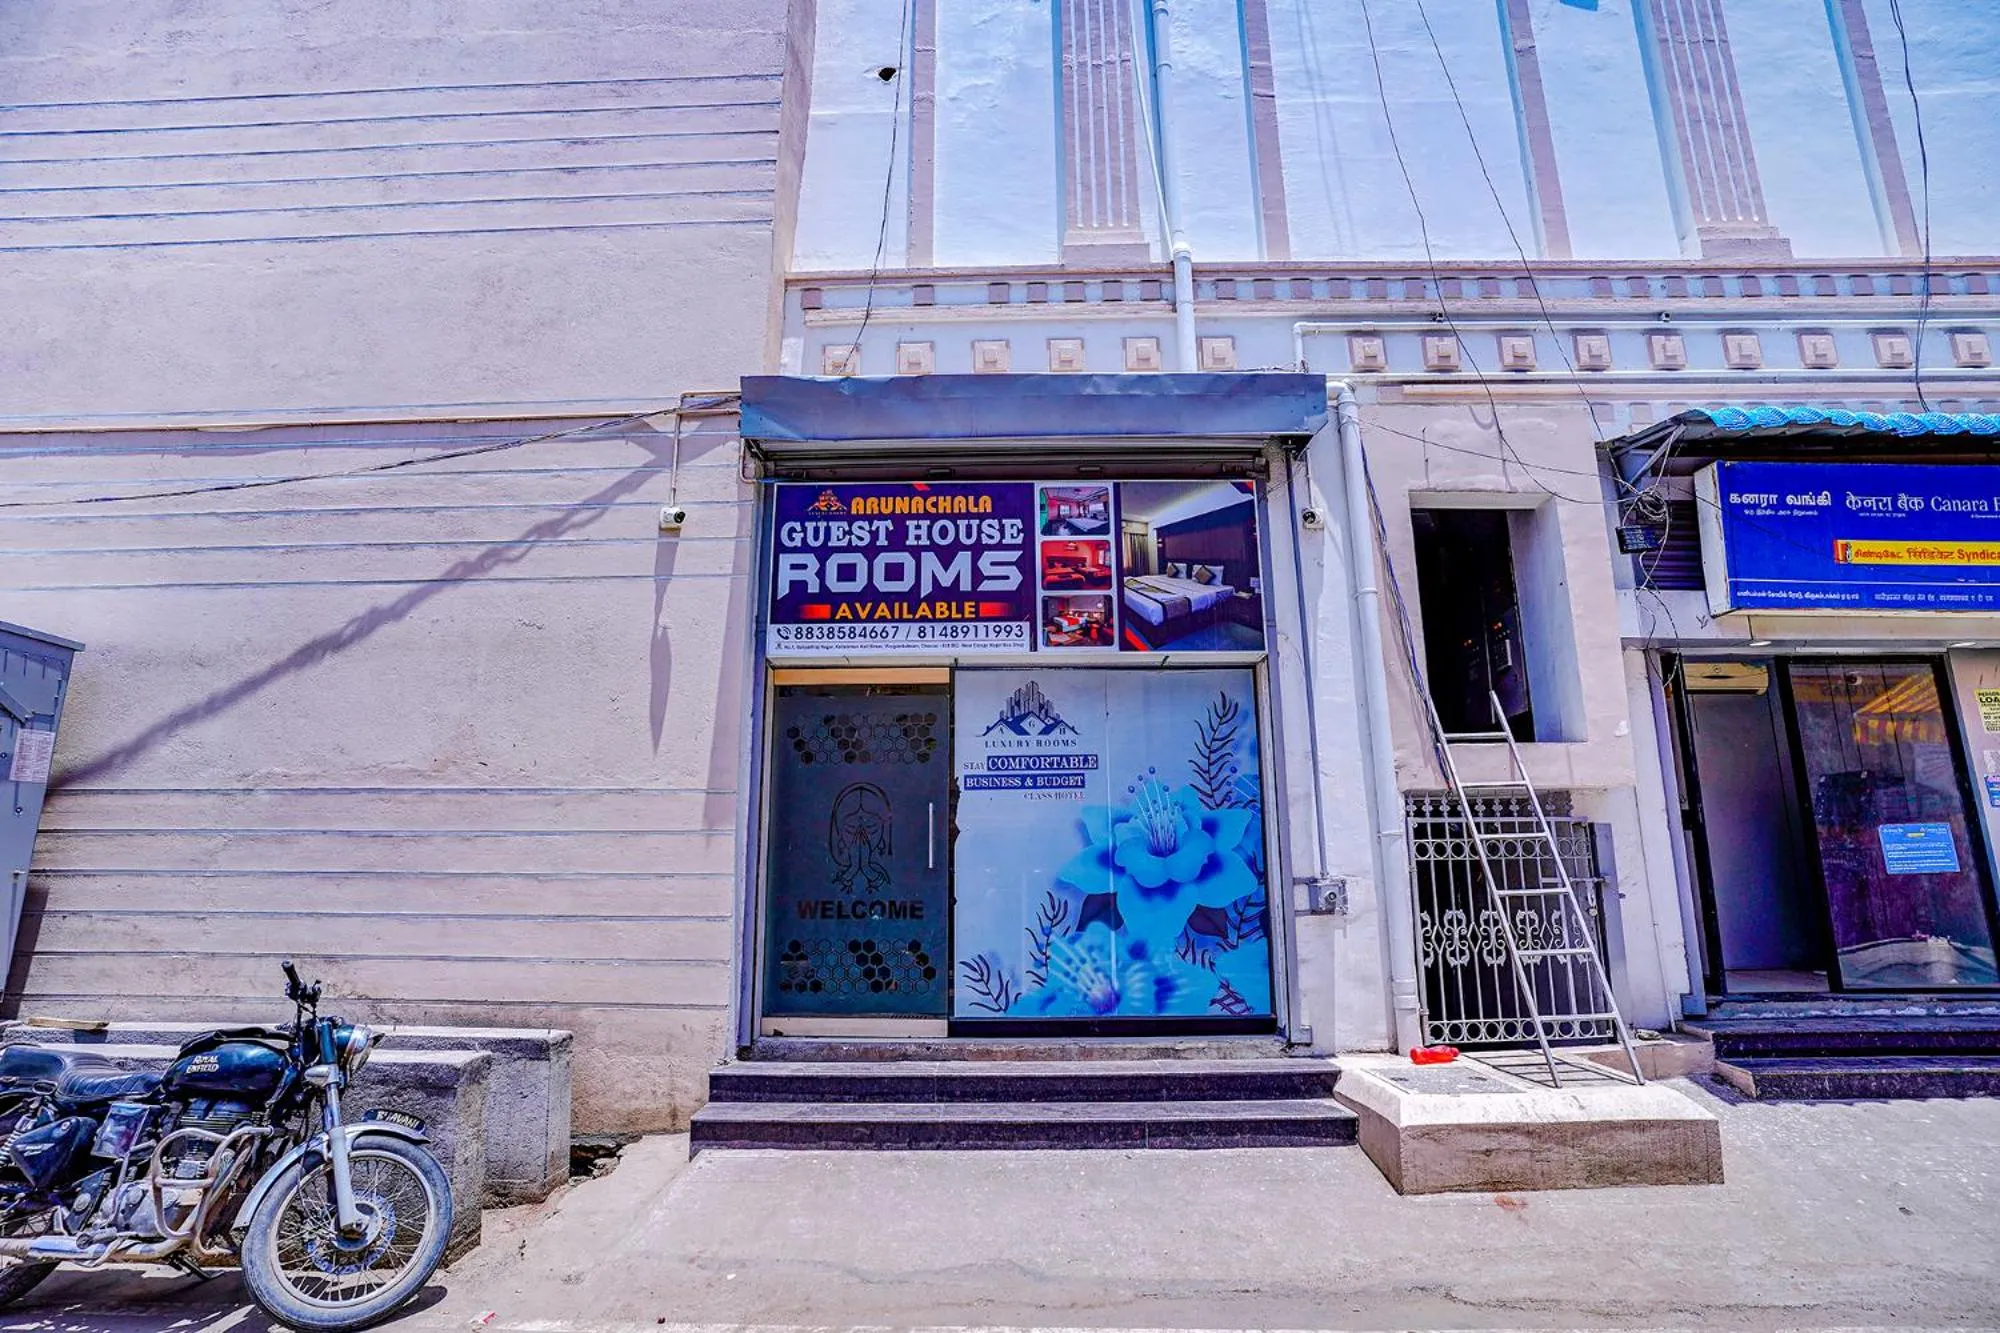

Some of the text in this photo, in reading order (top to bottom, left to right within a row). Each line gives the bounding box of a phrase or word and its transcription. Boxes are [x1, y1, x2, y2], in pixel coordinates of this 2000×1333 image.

[851, 495, 992, 515] ARUNACHALA
[1729, 490, 1832, 507] கனரா வங்கி
[1846, 491, 1893, 511] केनरा
[1931, 496, 1989, 512] Canara
[780, 518, 1024, 547] GUEST HOUSE
[777, 551, 1023, 600] ROOMS
[835, 601, 976, 620] AVAILABLE
[794, 626, 899, 640] 8838584667
[918, 624, 1024, 639] 8148911993
[984, 739, 1077, 748] LUXURY ROOMS
[964, 756, 1097, 771] STAY COMFORTABLE
[966, 775, 1084, 788] BUSINESS & BUDGET
[1055, 791, 1085, 800] HOTEL
[797, 900, 924, 920] WELCOME
